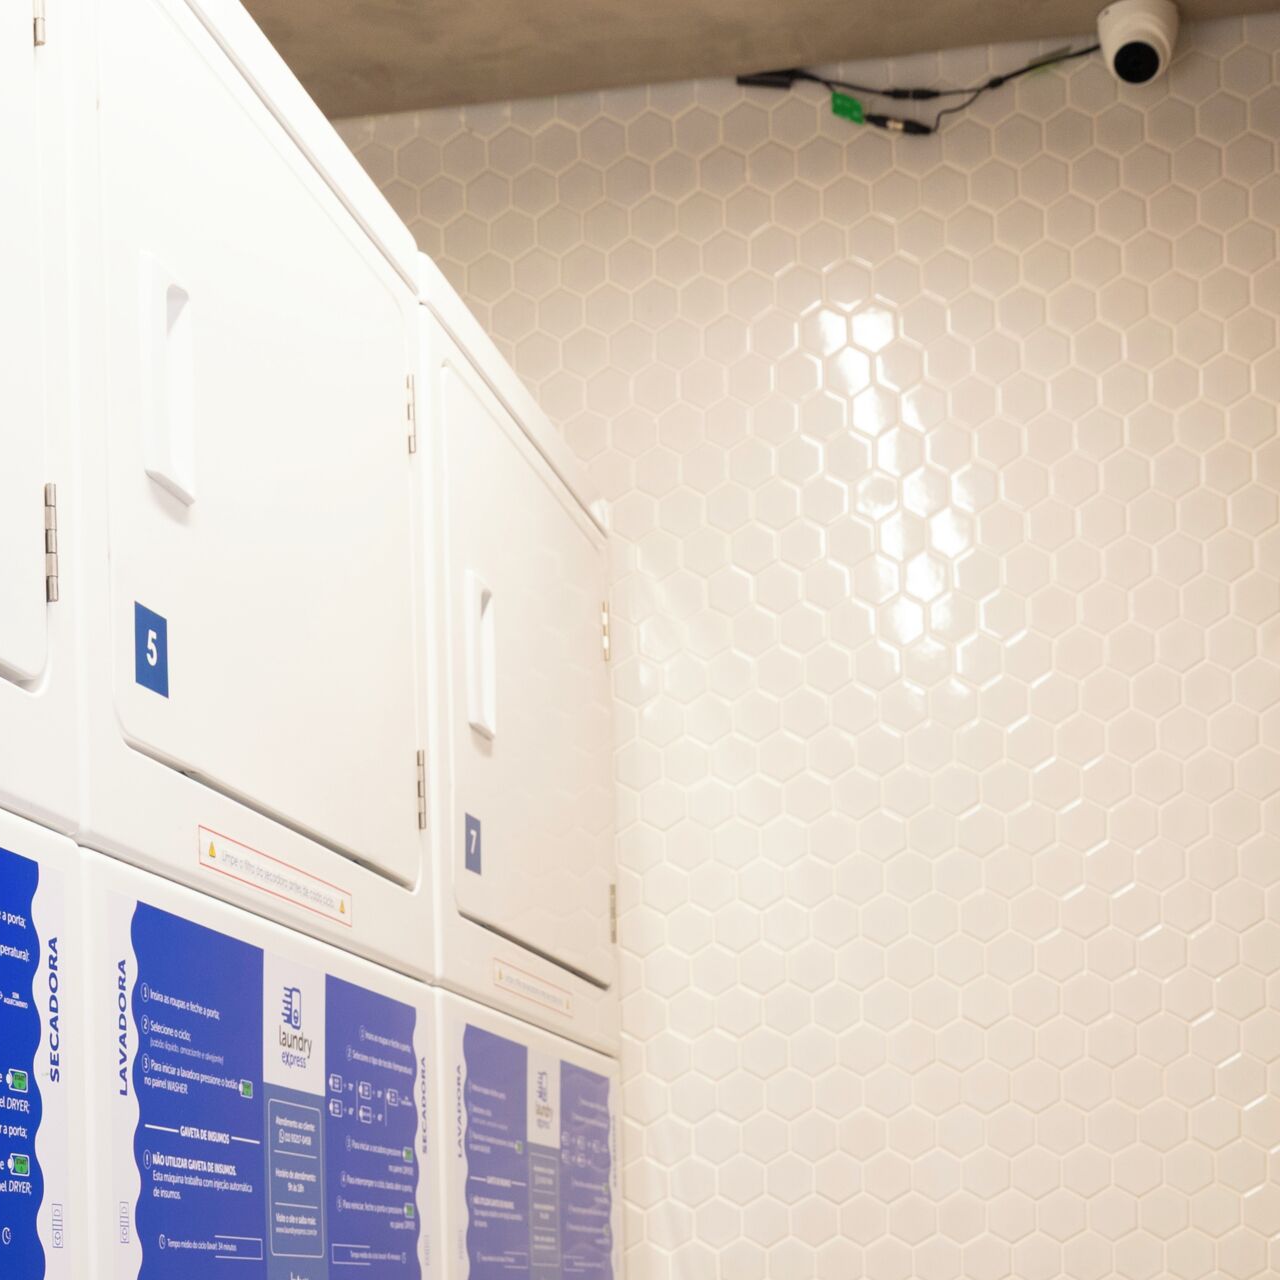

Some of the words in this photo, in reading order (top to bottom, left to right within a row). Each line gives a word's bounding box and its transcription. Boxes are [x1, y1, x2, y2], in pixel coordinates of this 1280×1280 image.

[146, 629, 158, 666] 5
[469, 829, 477, 854] 7
[48, 937, 60, 1083] SECADORA
[117, 959, 128, 1096] LAVADORA
[279, 1025, 312, 1059] laundry
